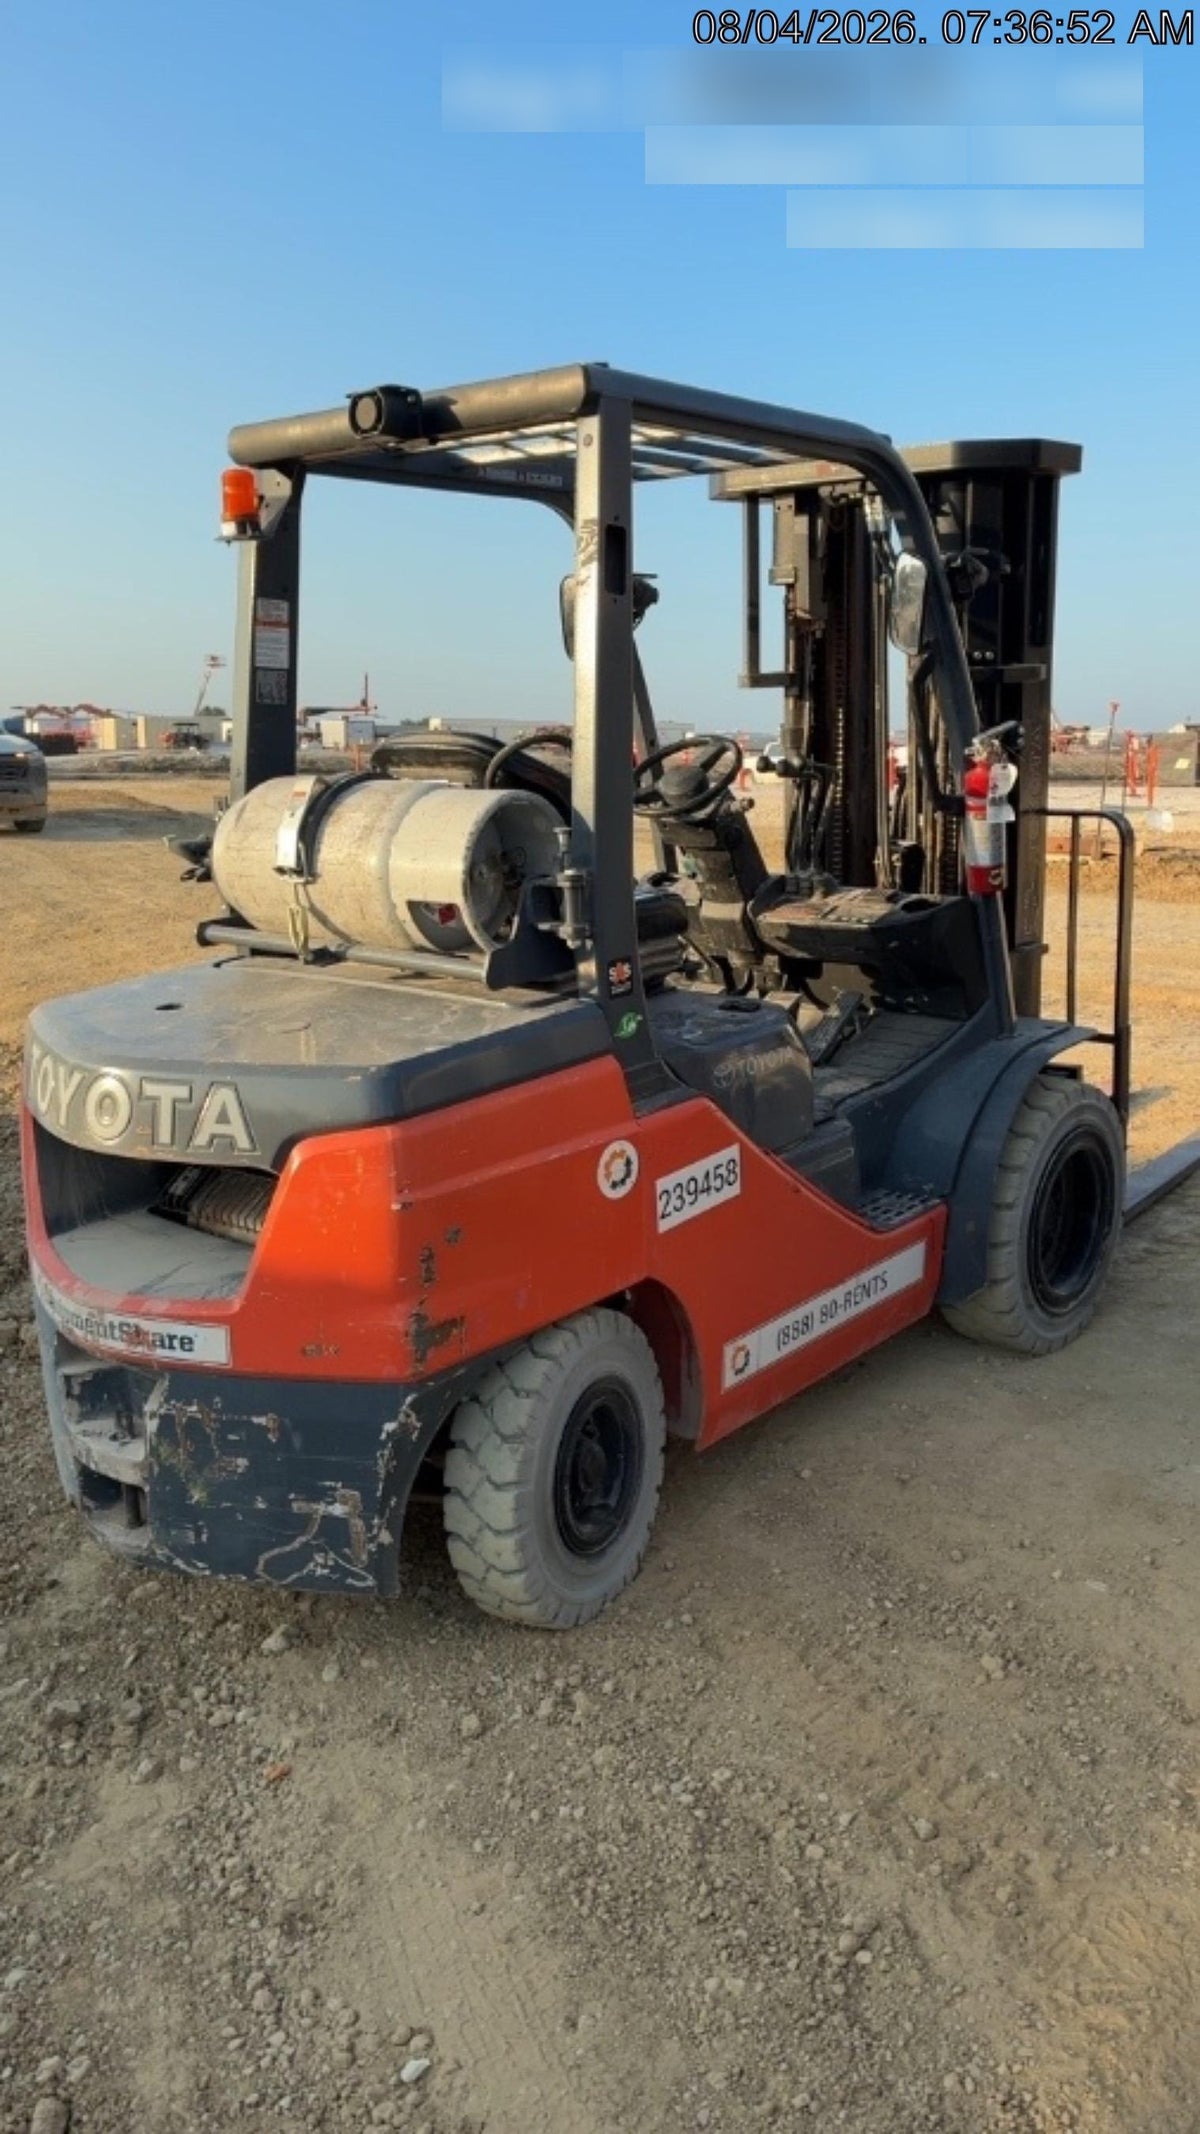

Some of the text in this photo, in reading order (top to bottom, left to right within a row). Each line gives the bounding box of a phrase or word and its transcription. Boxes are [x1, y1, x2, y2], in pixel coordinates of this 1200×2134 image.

[659, 1158, 738, 1219] 239458
[776, 1270, 889, 1351] (888) 80-RENTS
